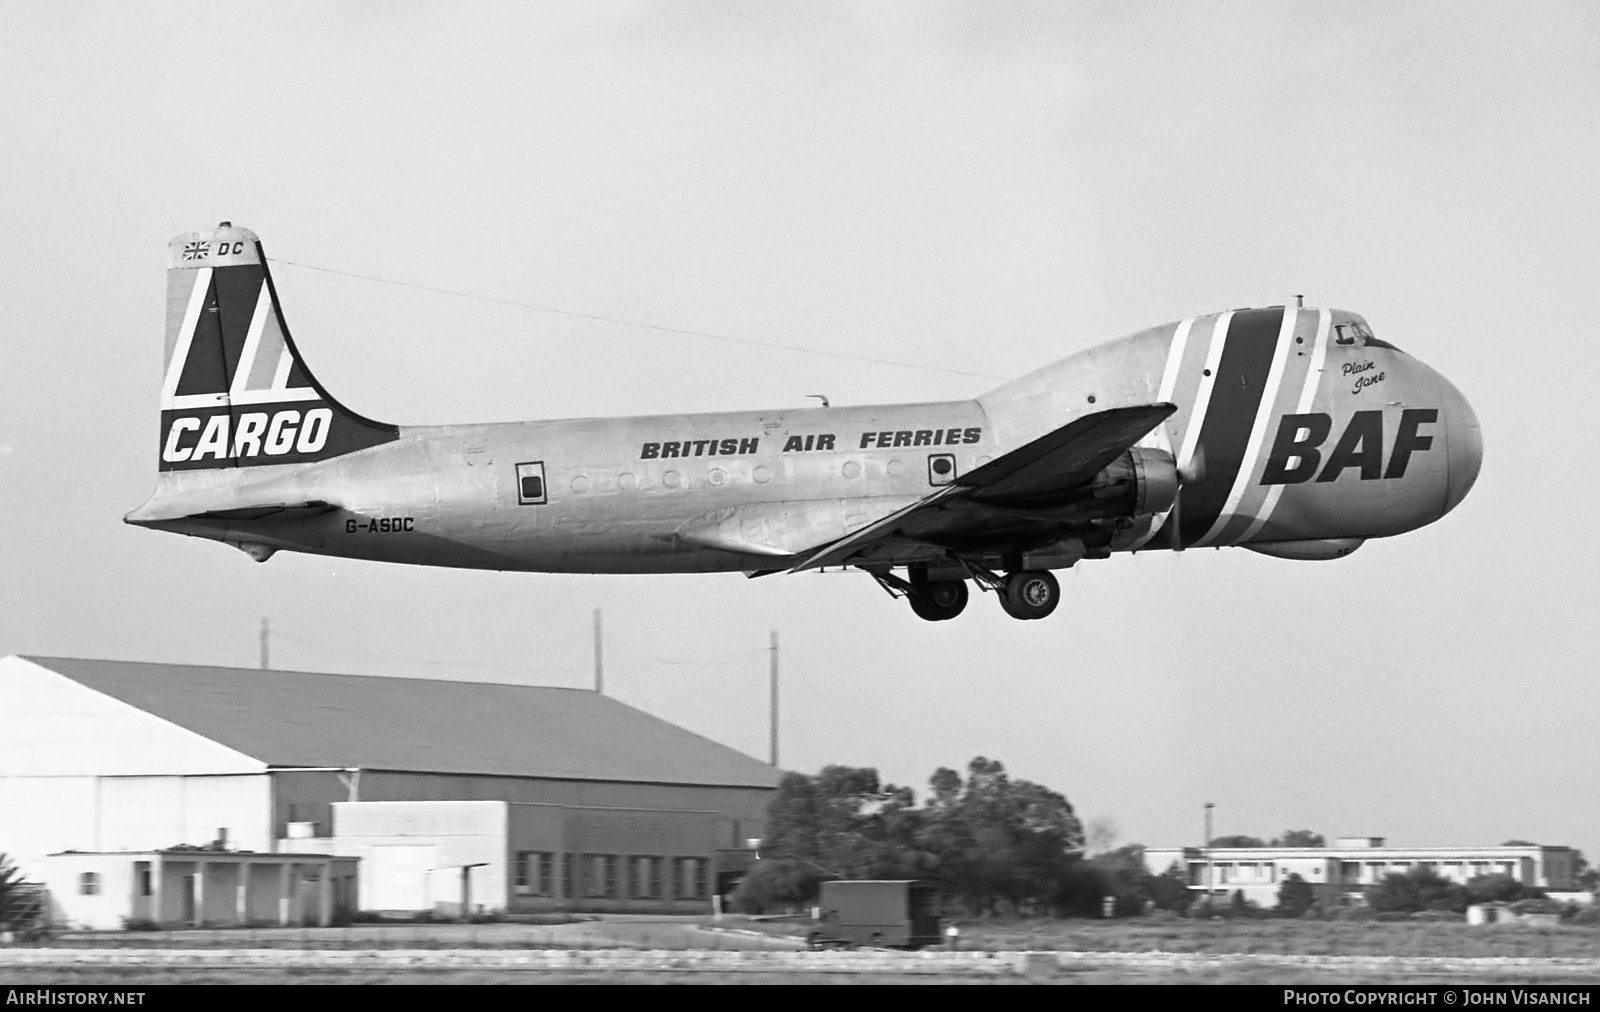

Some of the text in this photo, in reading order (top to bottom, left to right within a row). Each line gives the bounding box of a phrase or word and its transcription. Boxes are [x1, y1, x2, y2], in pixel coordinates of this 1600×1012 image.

[217, 241, 244, 257] DC
[1342, 359, 1375, 377] Plain
[1351, 371, 1386, 395] Jane
[162, 408, 333, 463] CARGO
[640, 427, 982, 460] BRITISH AIR FERRIES
[1259, 409, 1439, 486] BAF
[345, 517, 414, 534] G-ASDC
